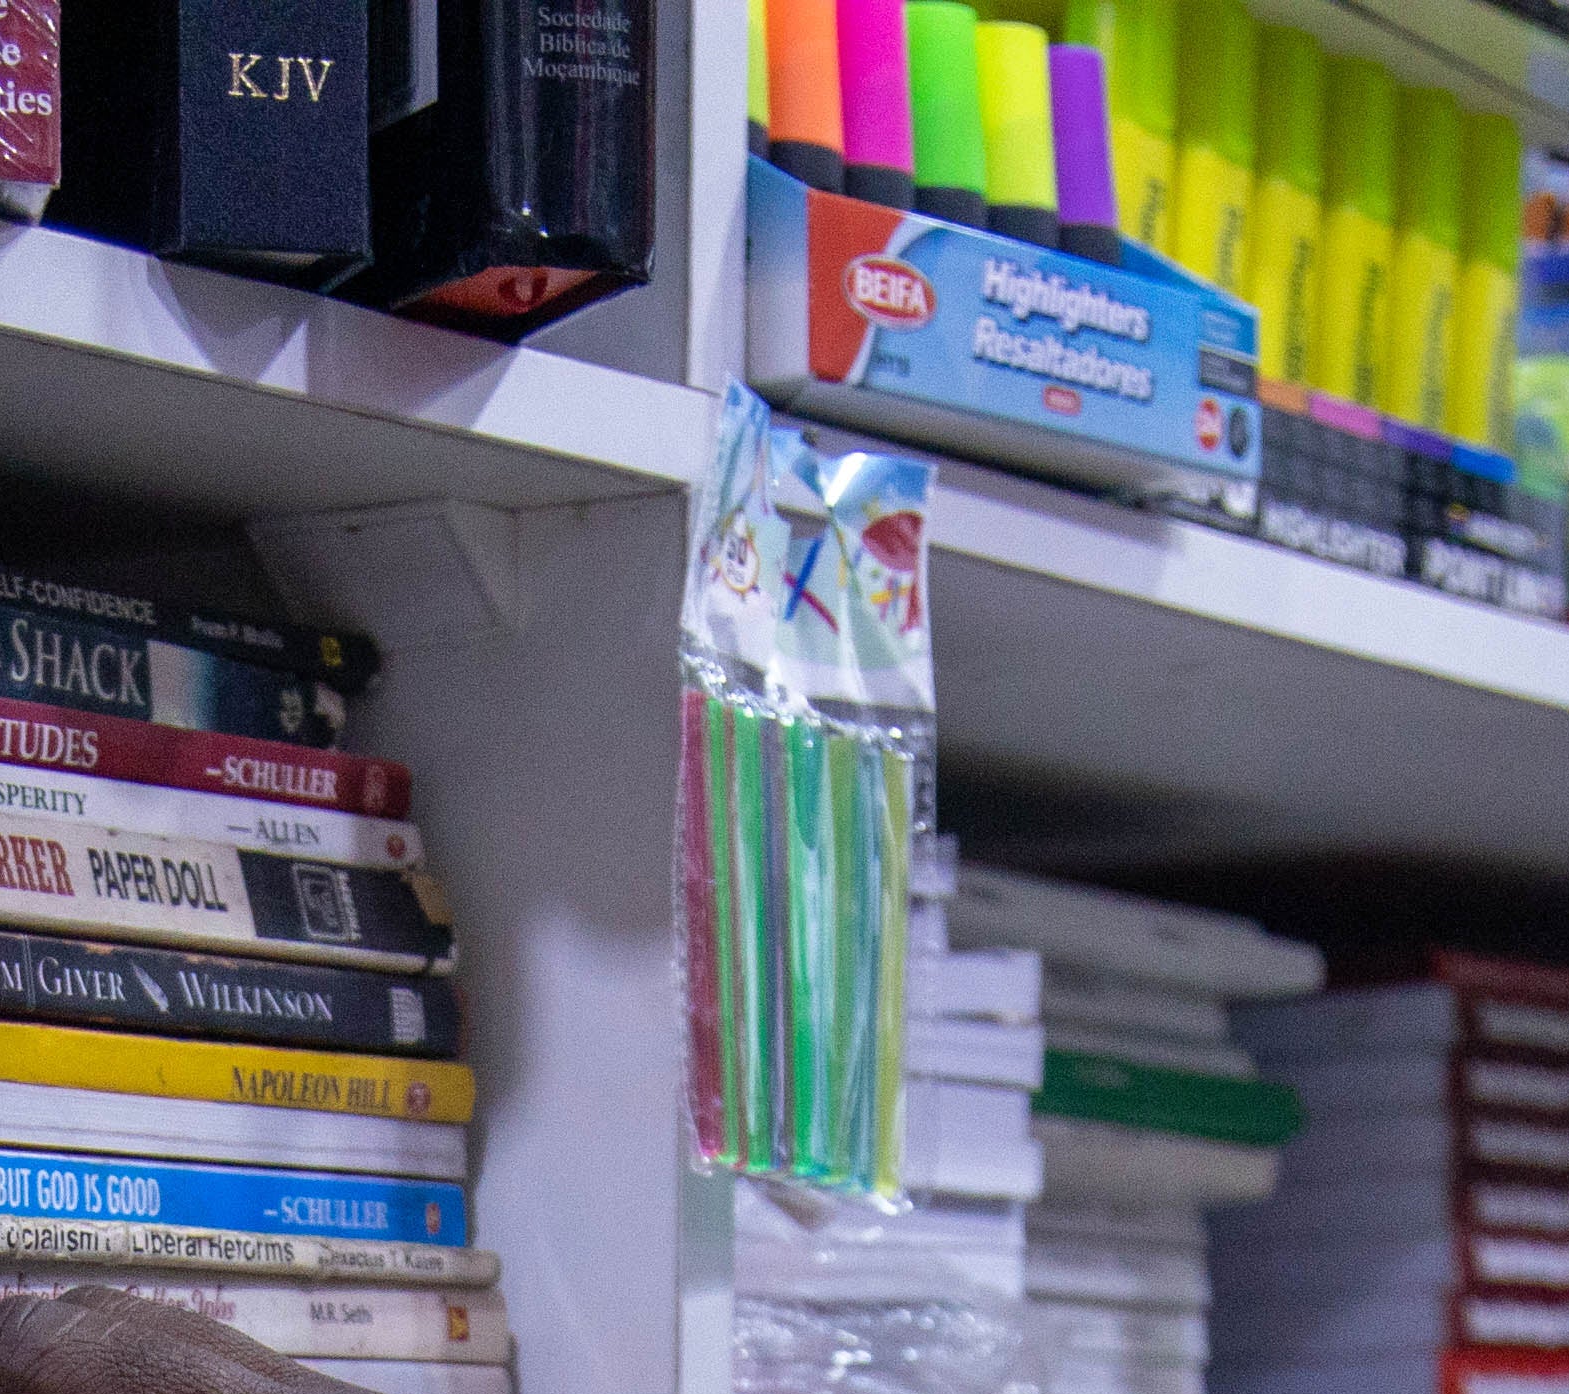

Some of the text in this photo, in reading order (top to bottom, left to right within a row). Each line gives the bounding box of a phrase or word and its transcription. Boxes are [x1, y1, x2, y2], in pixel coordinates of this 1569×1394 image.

[228, 52, 335, 102] KJV
[853, 266, 927, 320] BEIFA
[983, 260, 1151, 343] Highlighters
[971, 315, 1153, 402] Resaltadores
[9, 617, 146, 706] SHACK
[88, 847, 228, 913] PAPER DOLL
[232, 1066, 341, 1107] NAPOLEON
[37, 1170, 78, 1211] GOD
[84, 1174, 102, 1212] IS
[106, 1175, 160, 1217] GOOD
